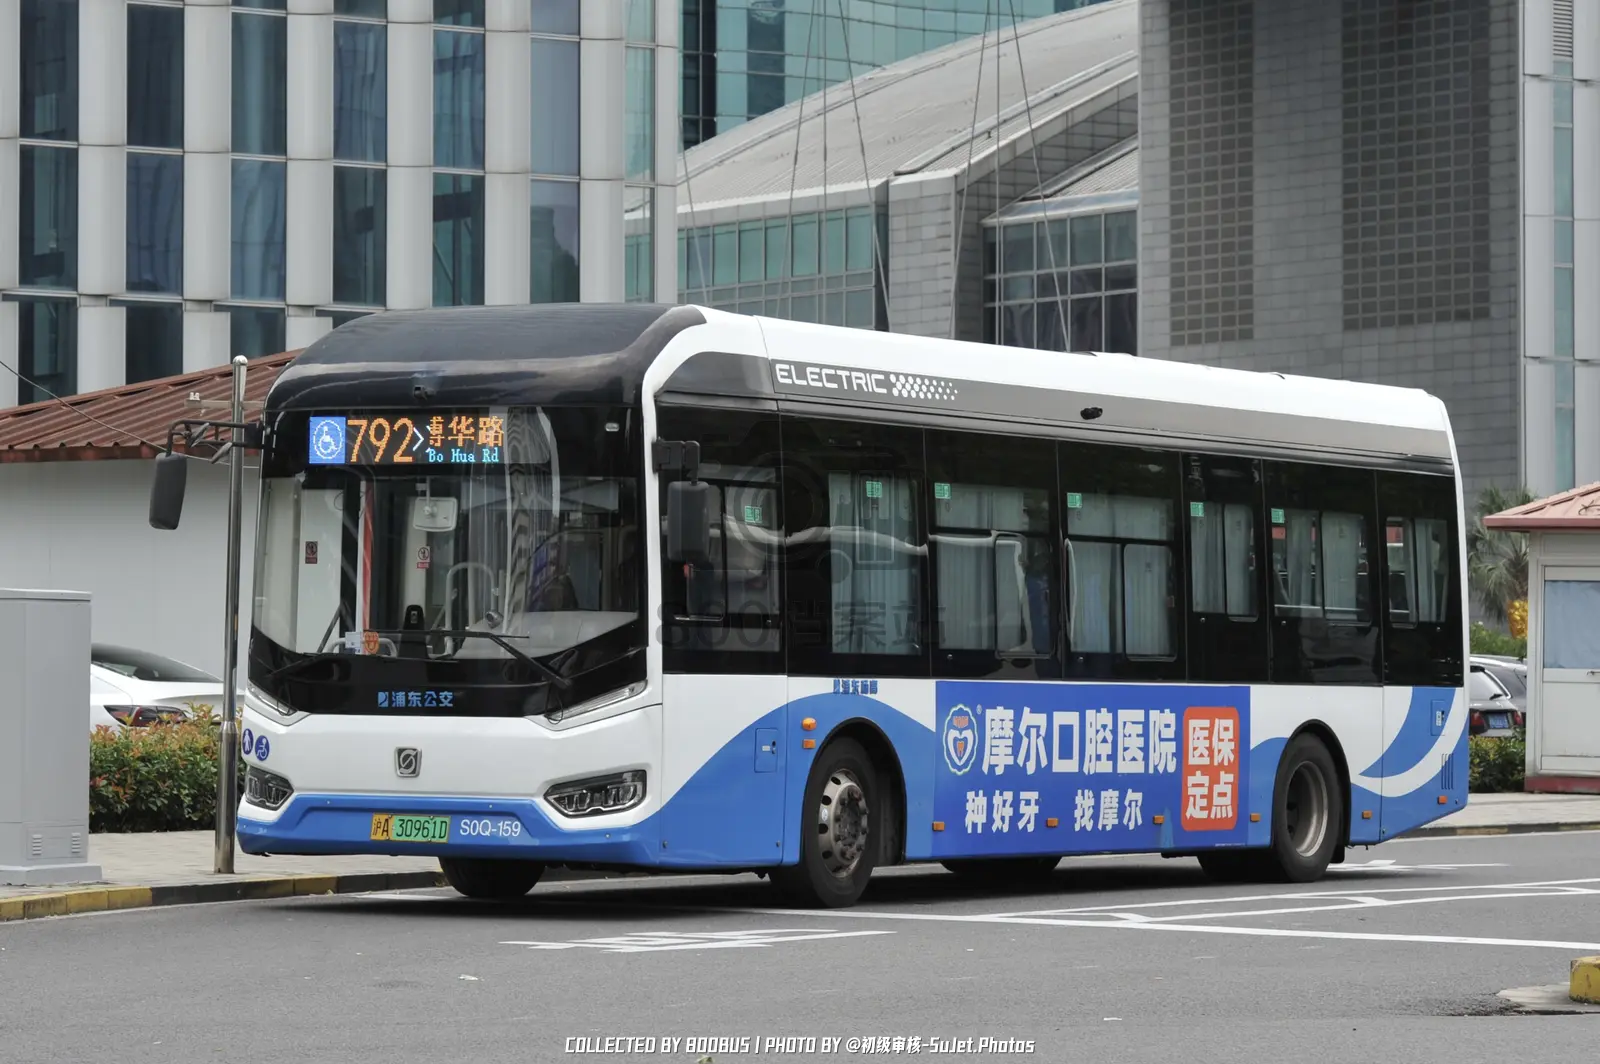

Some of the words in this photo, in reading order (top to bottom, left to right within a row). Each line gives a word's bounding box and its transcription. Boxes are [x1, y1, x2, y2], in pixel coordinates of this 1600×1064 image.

[775, 363, 888, 395] ELECTRIC
[347, 417, 414, 463] 792
[428, 448, 444, 462] Bo
[451, 448, 475, 462] Hua
[482, 448, 499, 462] Rd
[391, 691, 454, 708] 浦东公交
[981, 706, 1177, 775] 摩尔口腔医院
[1188, 719, 1236, 766] 医保
[965, 789, 1039, 834] 种好牙
[1074, 788, 1143, 832] 找摩尔
[1185, 771, 1234, 820] 定点
